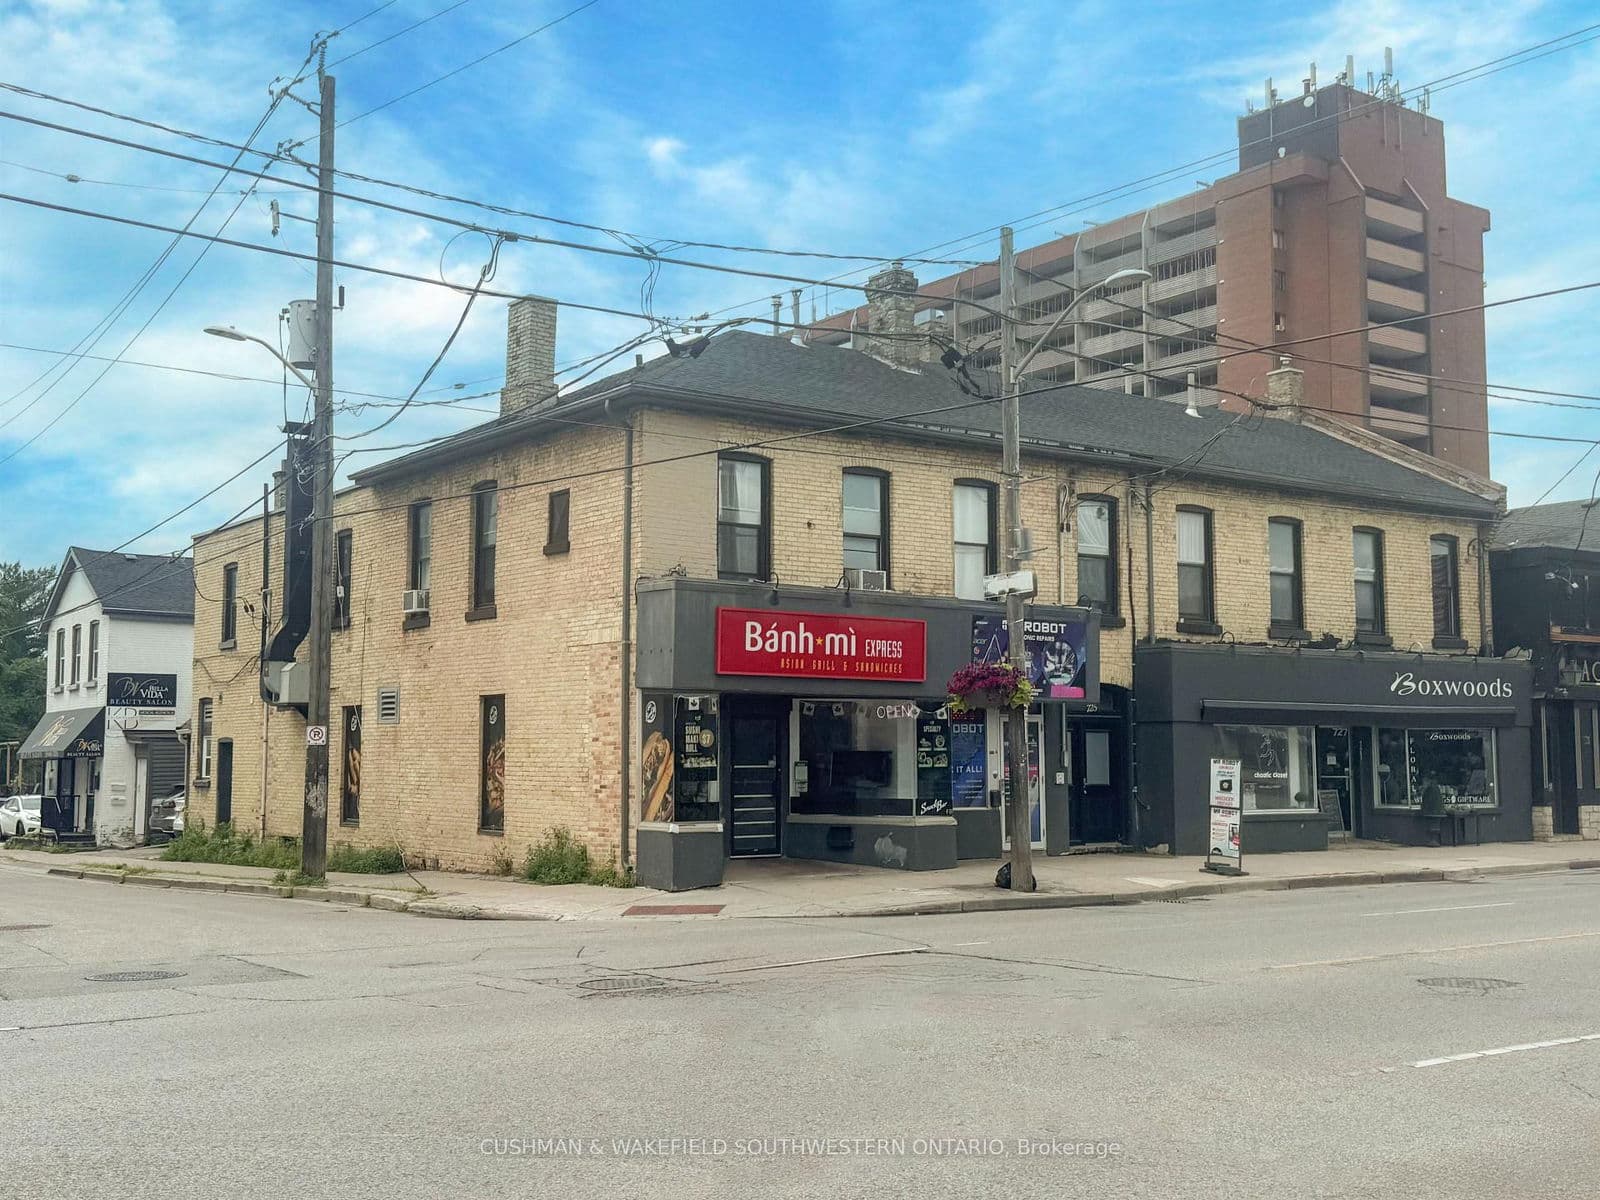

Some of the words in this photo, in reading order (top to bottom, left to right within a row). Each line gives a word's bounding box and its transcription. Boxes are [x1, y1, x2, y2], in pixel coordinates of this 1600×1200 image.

[1024, 621, 1067, 633] ROBOT
[745, 621, 814, 654] Bánh
[825, 627, 856, 657] mì
[865, 639, 903, 658] EXPRESS
[812, 661, 836, 671] GRILL
[1390, 671, 1513, 698] Boxwoods
[877, 704, 913, 718] OPEN
[953, 723, 984, 733] OBOT
[1429, 732, 1471, 740] Boxwoods
